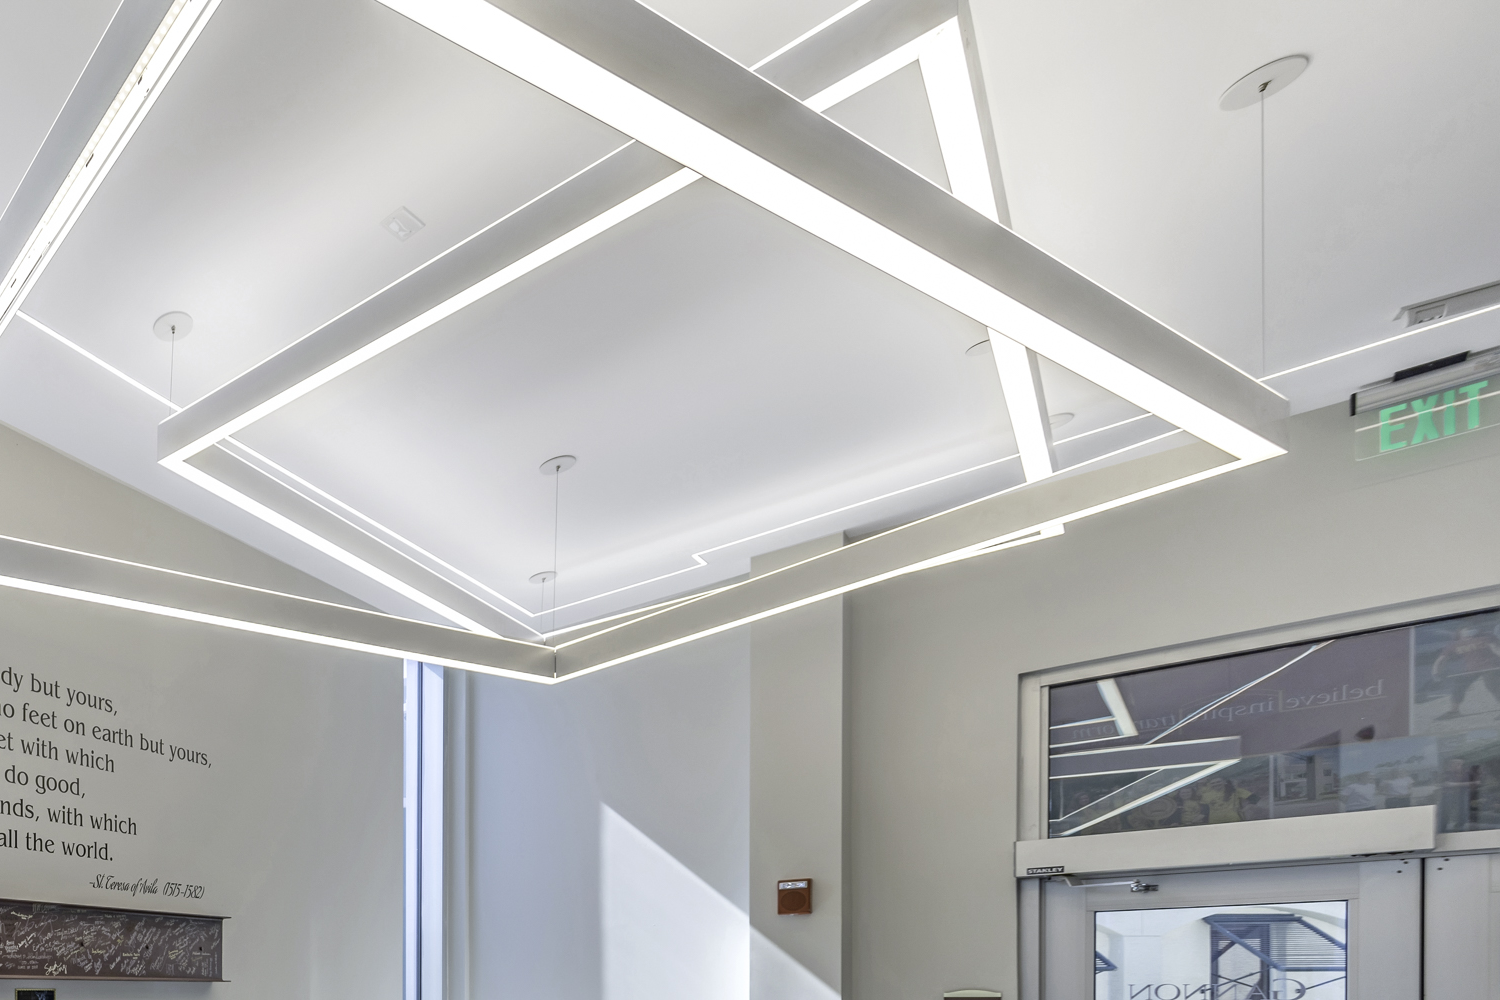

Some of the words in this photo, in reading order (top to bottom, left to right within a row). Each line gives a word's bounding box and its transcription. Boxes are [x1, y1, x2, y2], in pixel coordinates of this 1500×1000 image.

[1379, 380, 1489, 453] EXIT
[30, 672, 61, 700] but
[66, 687, 118, 716] yours,
[22, 702, 58, 730] feet
[63, 717, 86, 737] on
[91, 724, 134, 748] earth
[139, 732, 165, 756] but
[168, 744, 212, 769] yours,
[20, 737, 59, 761] with
[65, 748, 115, 773] which
[4, 764, 29, 786] do
[35, 774, 86, 799] good,
[47, 805, 84, 827] with
[90, 813, 138, 836] which
[25, 831, 55, 854] the
[61, 841, 114, 862] world.
[105, 875, 130, 893] Teresa
[130, 877, 143, 898] of
[1027, 866, 1064, 875] STANLEY
